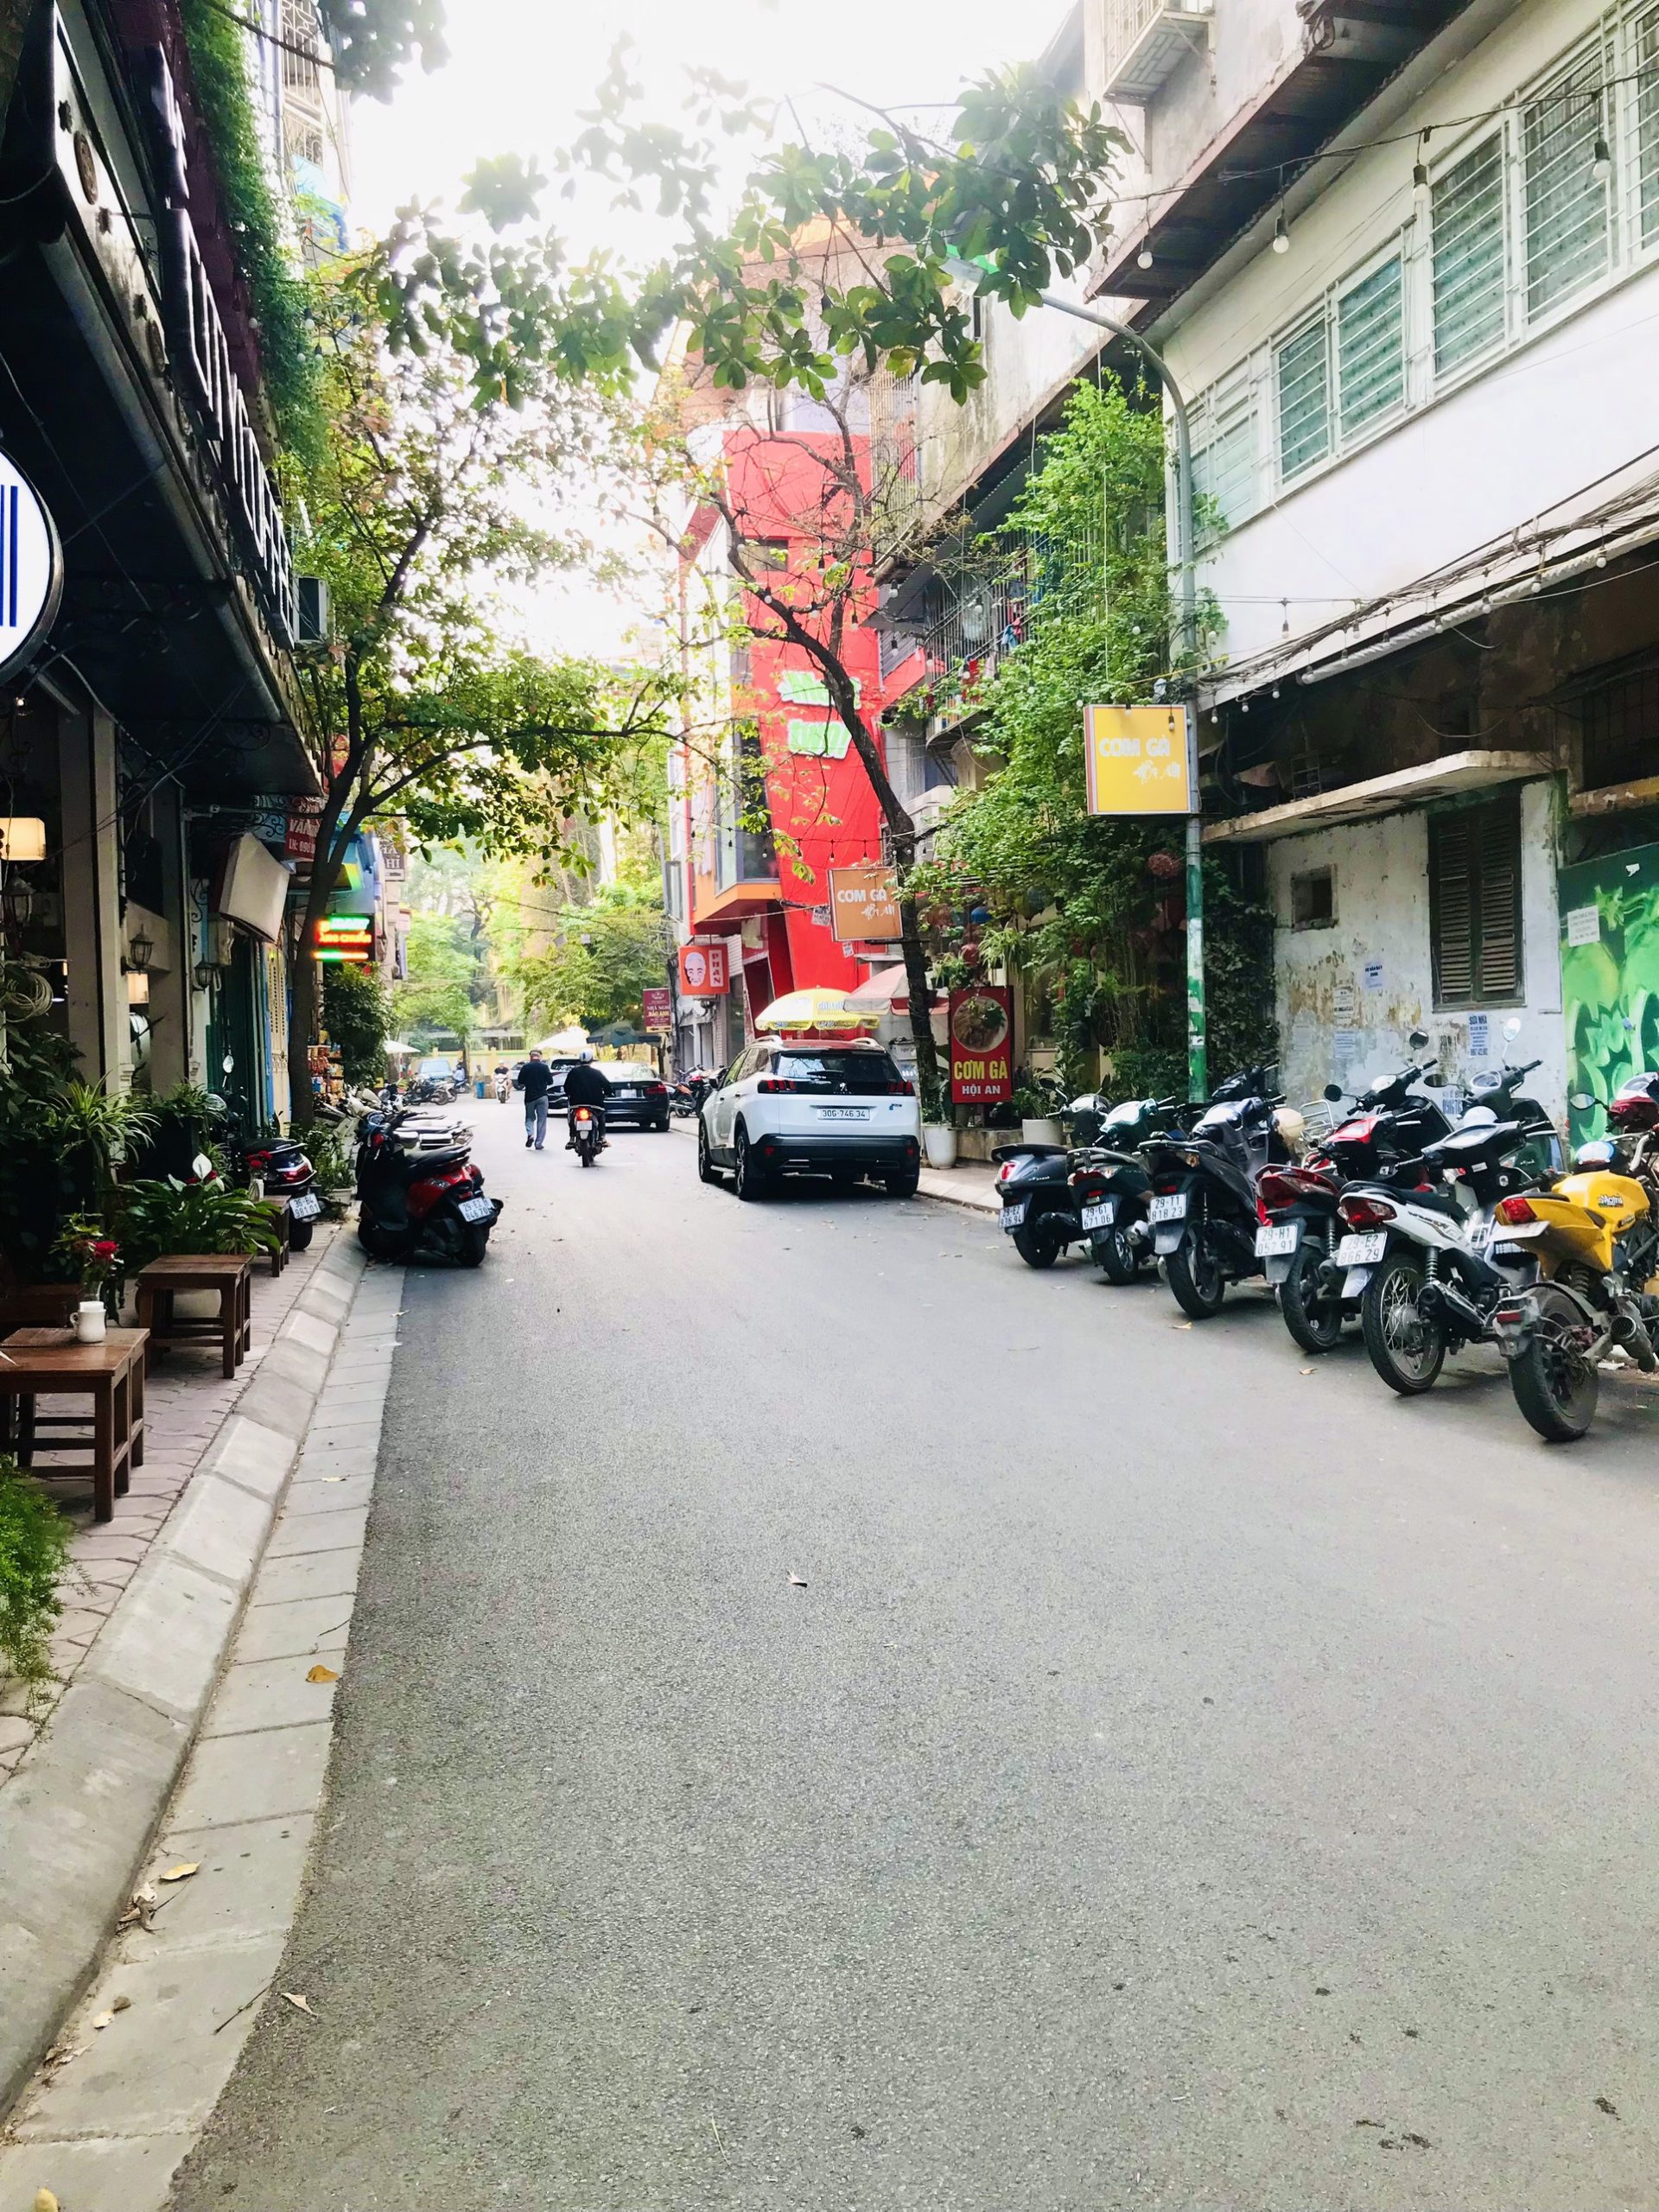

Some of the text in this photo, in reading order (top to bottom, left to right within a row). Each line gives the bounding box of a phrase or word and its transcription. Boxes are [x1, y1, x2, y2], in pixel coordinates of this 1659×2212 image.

[954, 1056, 1008, 1080] CƠM GÀ
[962, 1084, 1001, 1096] HỘI AN
[1155, 1195, 1180, 1208] 29-T1
[1085, 1206, 1108, 1217] 29-G1
[1262, 1227, 1290, 1241] 29-H1
[1347, 1235, 1378, 1249] 29-E2
